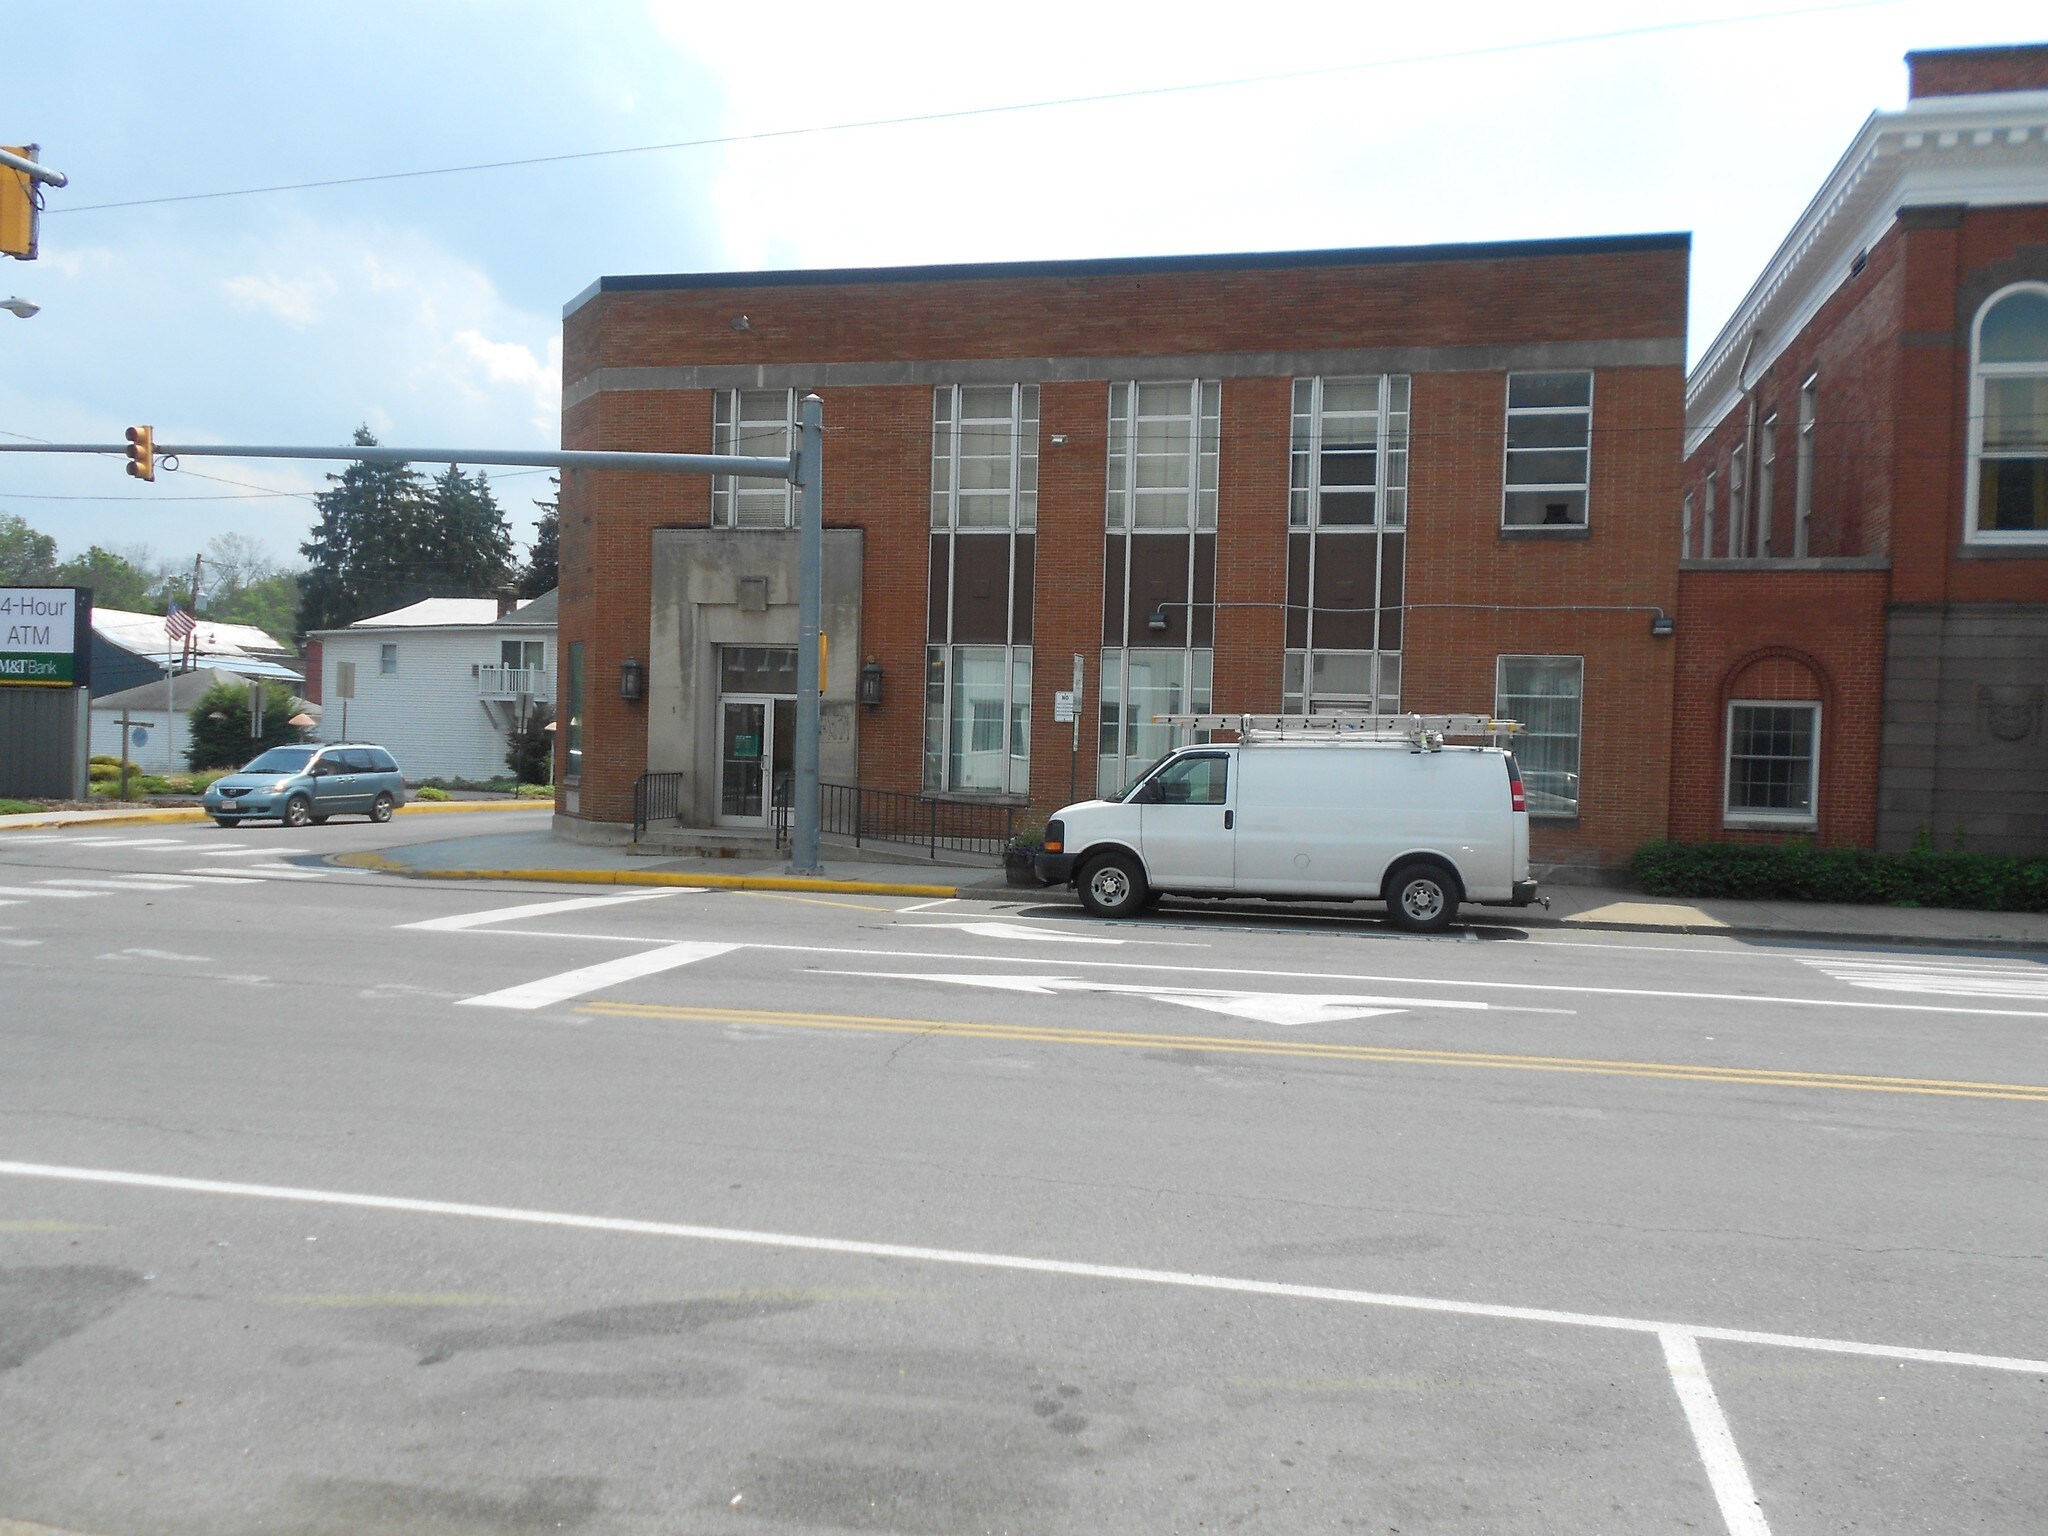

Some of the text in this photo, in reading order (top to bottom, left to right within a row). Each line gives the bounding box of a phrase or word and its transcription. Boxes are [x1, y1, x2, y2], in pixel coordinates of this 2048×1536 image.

[7, 625, 50, 645] ATM
[0, 659, 57, 674] M&T Bank
